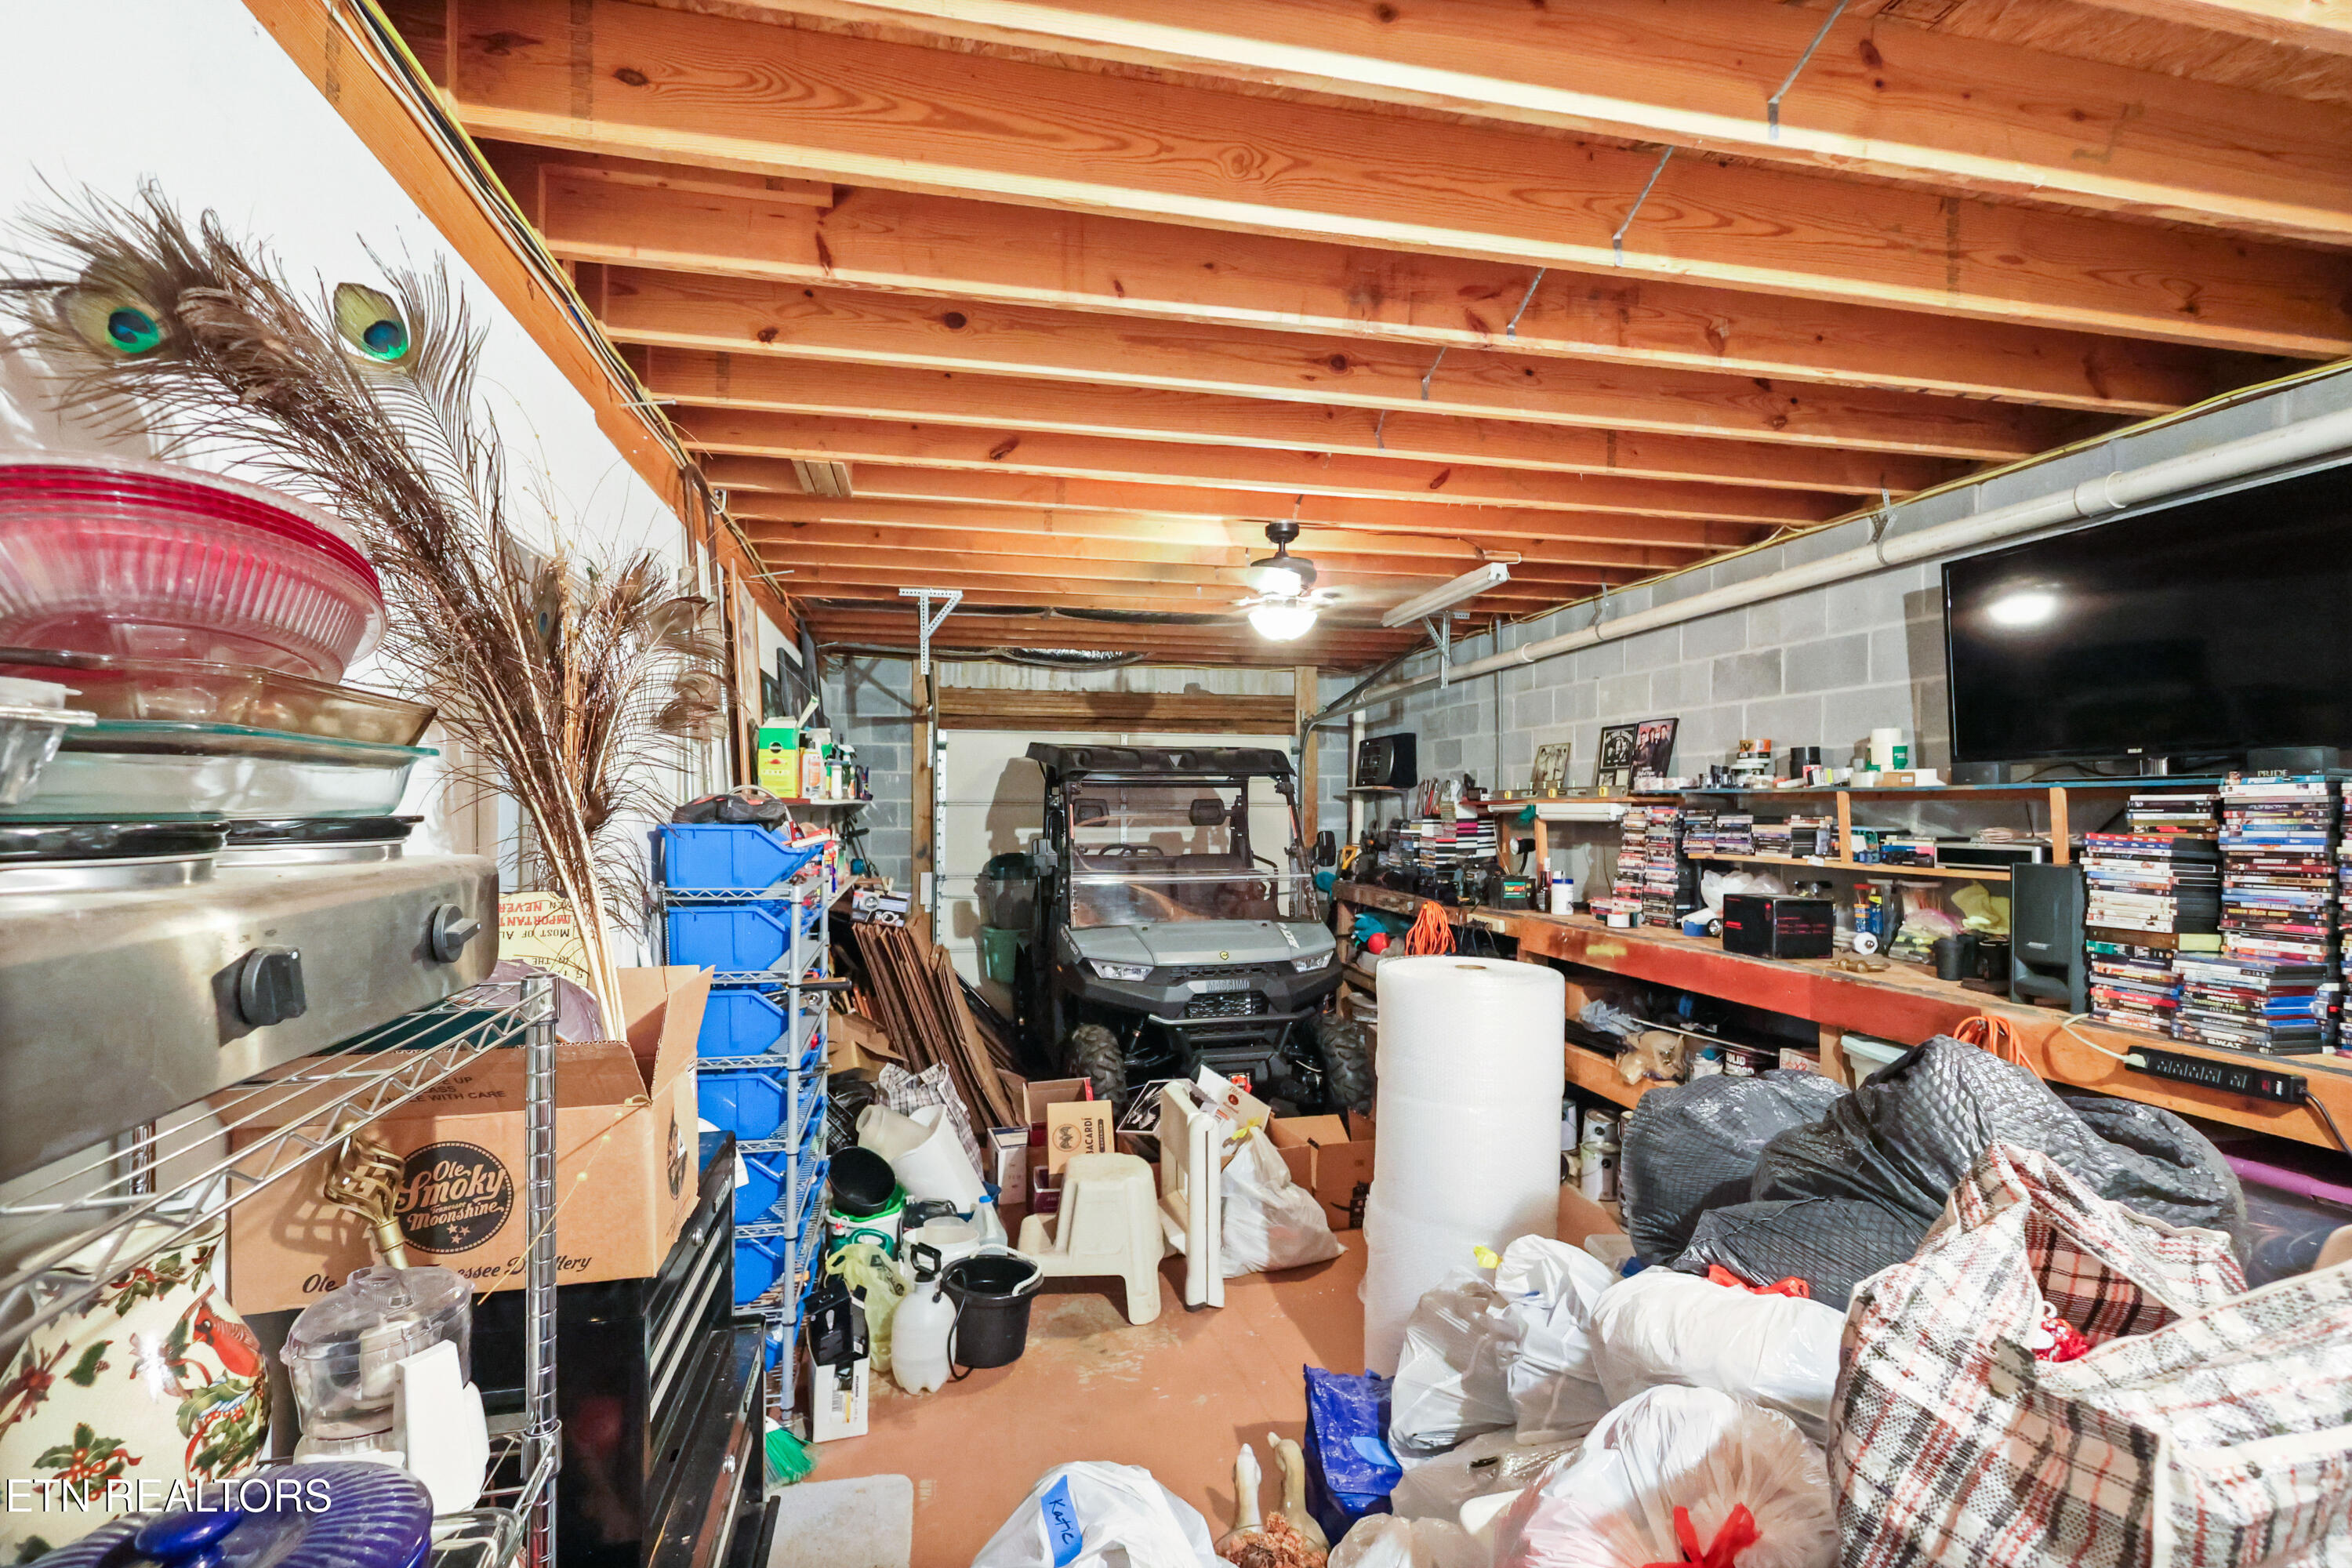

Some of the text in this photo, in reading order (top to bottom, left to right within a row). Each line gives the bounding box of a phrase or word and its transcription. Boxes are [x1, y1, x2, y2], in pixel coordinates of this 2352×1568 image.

[499, 902, 542, 913] NEVER
[499, 915, 571, 927] IMPORTANT
[499, 928, 570, 939] MOST OF AL
[1206, 980, 1250, 992] MASSIMO
[453, 1076, 472, 1085] UP
[428, 1093, 463, 1102] WITH
[468, 1091, 506, 1099] CARE
[433, 1160, 471, 1181] Ole
[395, 1163, 507, 1213] Smoky
[407, 1200, 504, 1232] Moonshine
[302, 1273, 340, 1294] Ole
